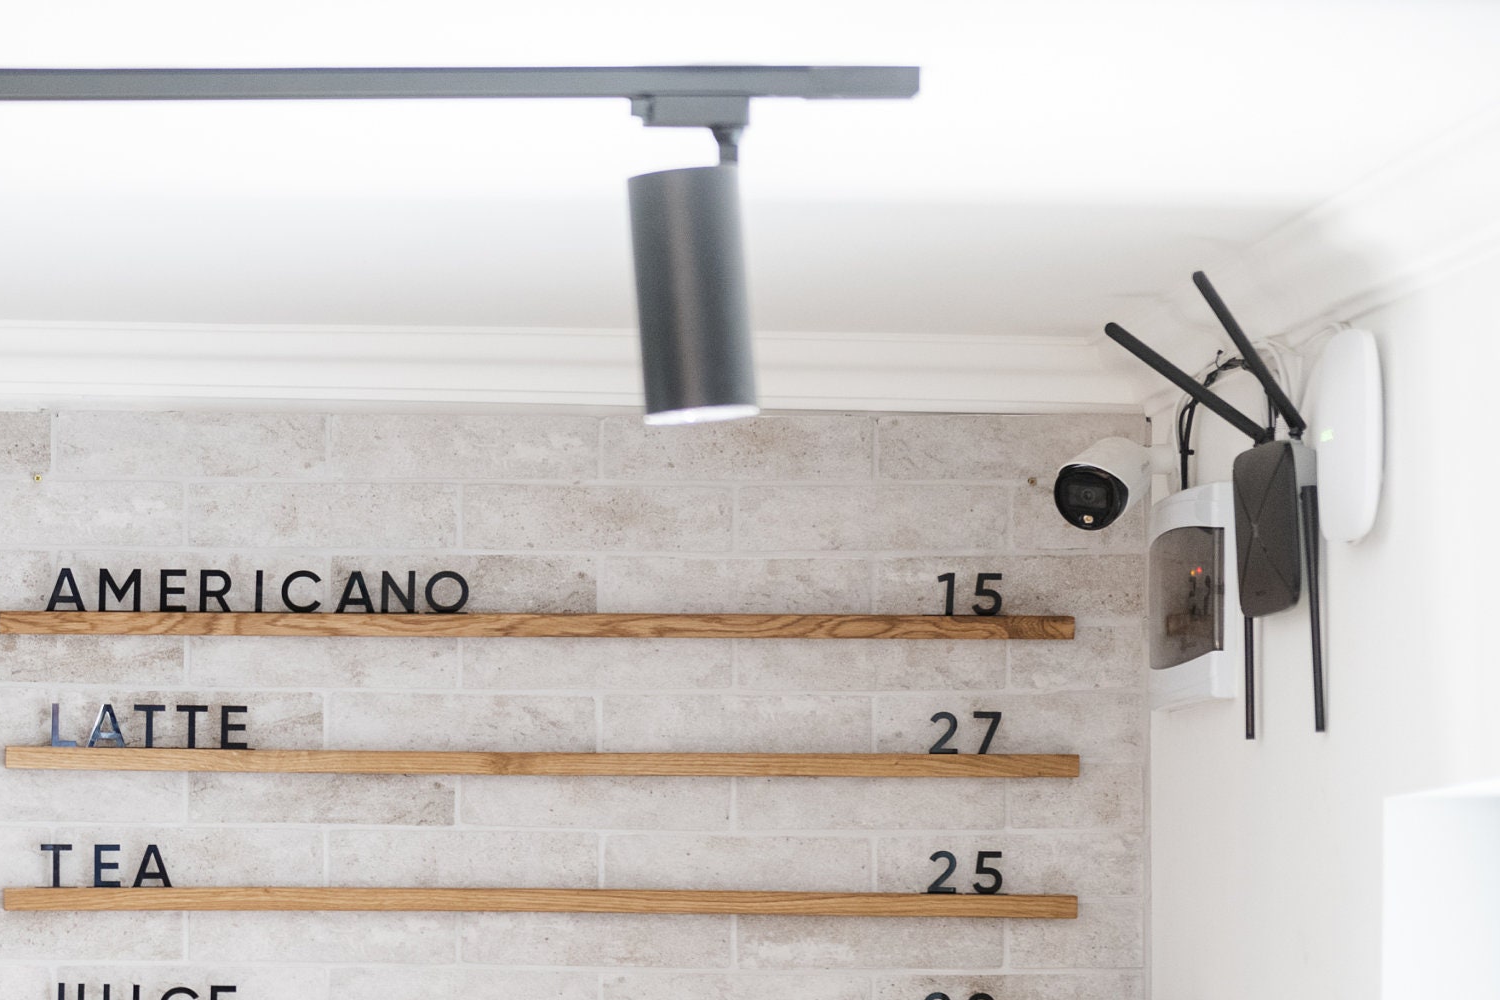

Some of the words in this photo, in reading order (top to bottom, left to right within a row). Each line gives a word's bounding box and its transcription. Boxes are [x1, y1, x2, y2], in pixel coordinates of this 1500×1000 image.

[45, 568, 470, 614] AMERICANO
[937, 572, 1003, 616] 15
[51, 703, 248, 750] LATTE
[929, 711, 1002, 755] 27
[41, 844, 173, 889] TEA
[927, 851, 1003, 894] 25
